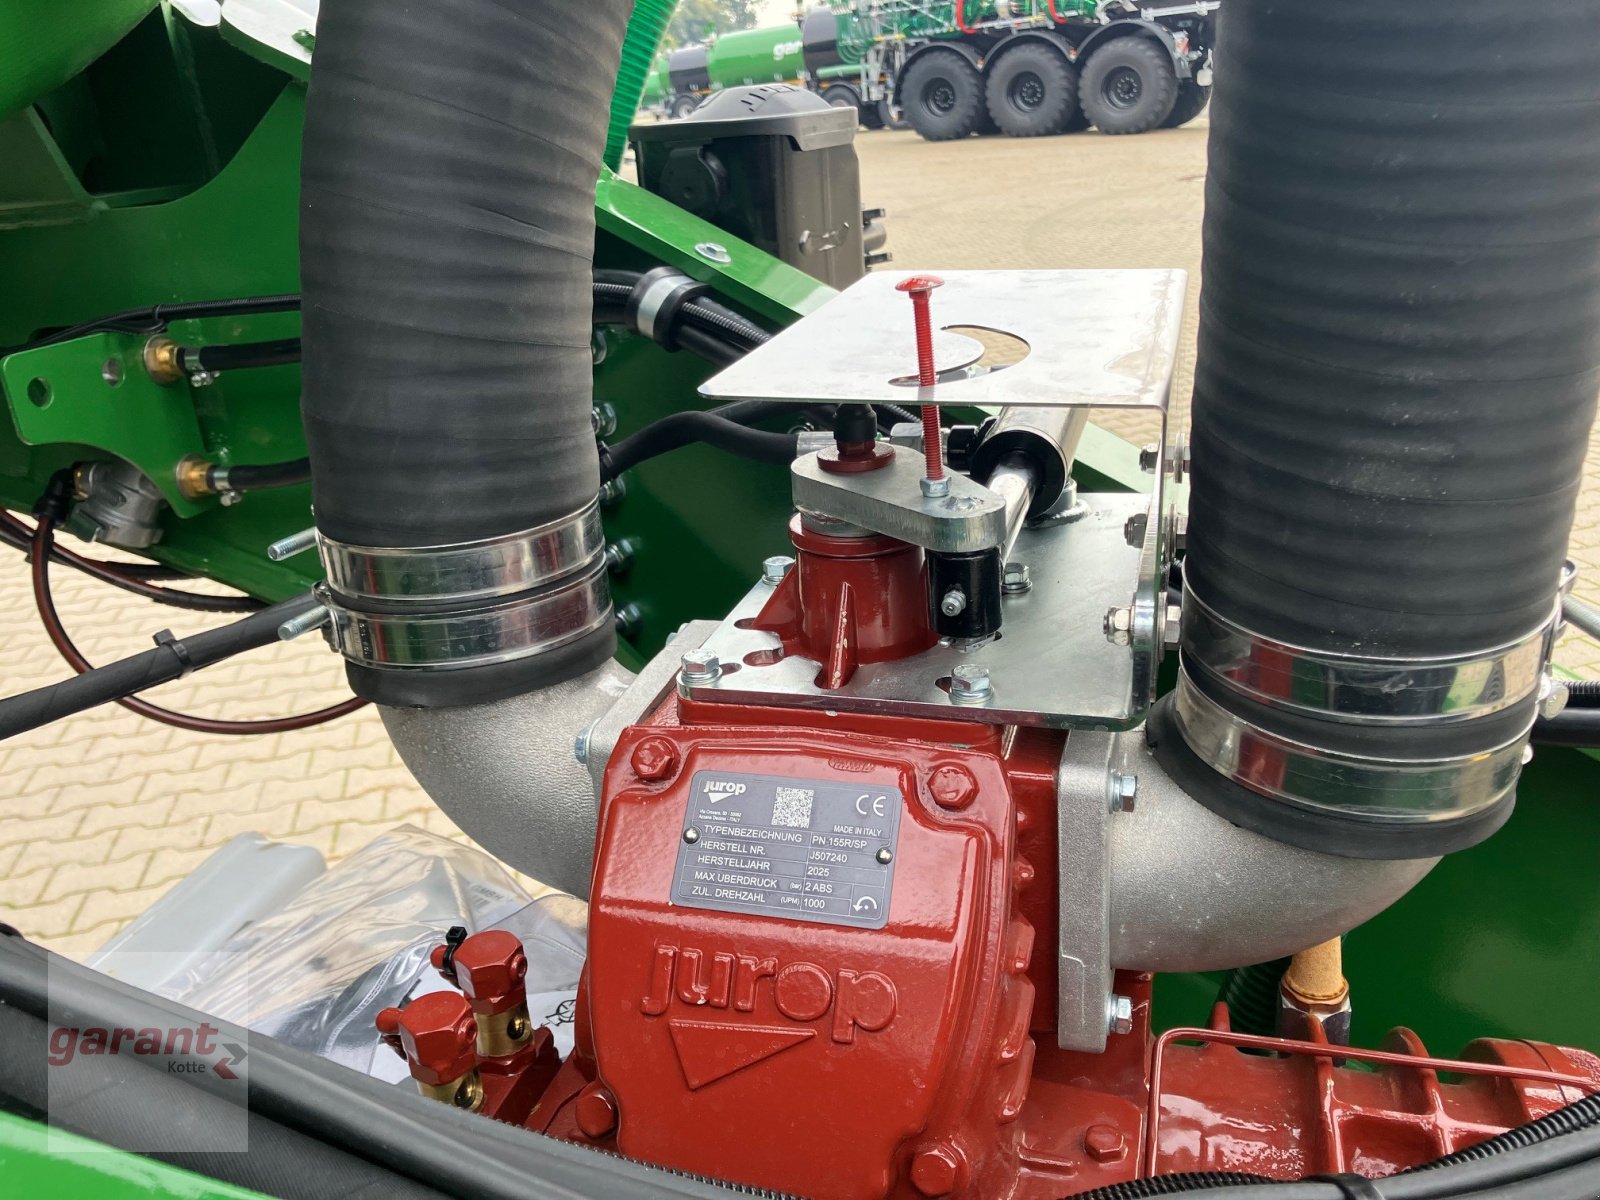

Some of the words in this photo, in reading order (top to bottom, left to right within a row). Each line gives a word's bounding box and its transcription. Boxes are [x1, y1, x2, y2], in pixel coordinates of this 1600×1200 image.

[703, 780, 747, 796] jurop
[855, 794, 887, 817] CE
[704, 824, 803, 843] TYPENBEZEICHNUNG
[833, 825, 854, 834] MADE
[854, 827, 863, 835] IN
[863, 828, 882, 837] ITALY
[700, 840, 748, 853] HERSTELL
[749, 845, 766, 855] NR.
[811, 835, 826, 846] PN
[829, 837, 868, 849] 155R/SP
[697, 854, 771, 871] HERSTELLJAHR
[809, 851, 848, 863] J507240
[807, 866, 830, 877] 2025
[694, 870, 716, 882] MAX
[789, 882, 802, 891] (bar)
[804, 882, 811, 891] 2
[812, 883, 833, 893] ABS
[691, 886, 712, 897] ZUL.
[714, 888, 766, 903] DREHZAHL
[780, 896, 800, 906] (UPM)
[803, 898, 826, 909] 1000
[640, 942, 898, 1044] jurop
